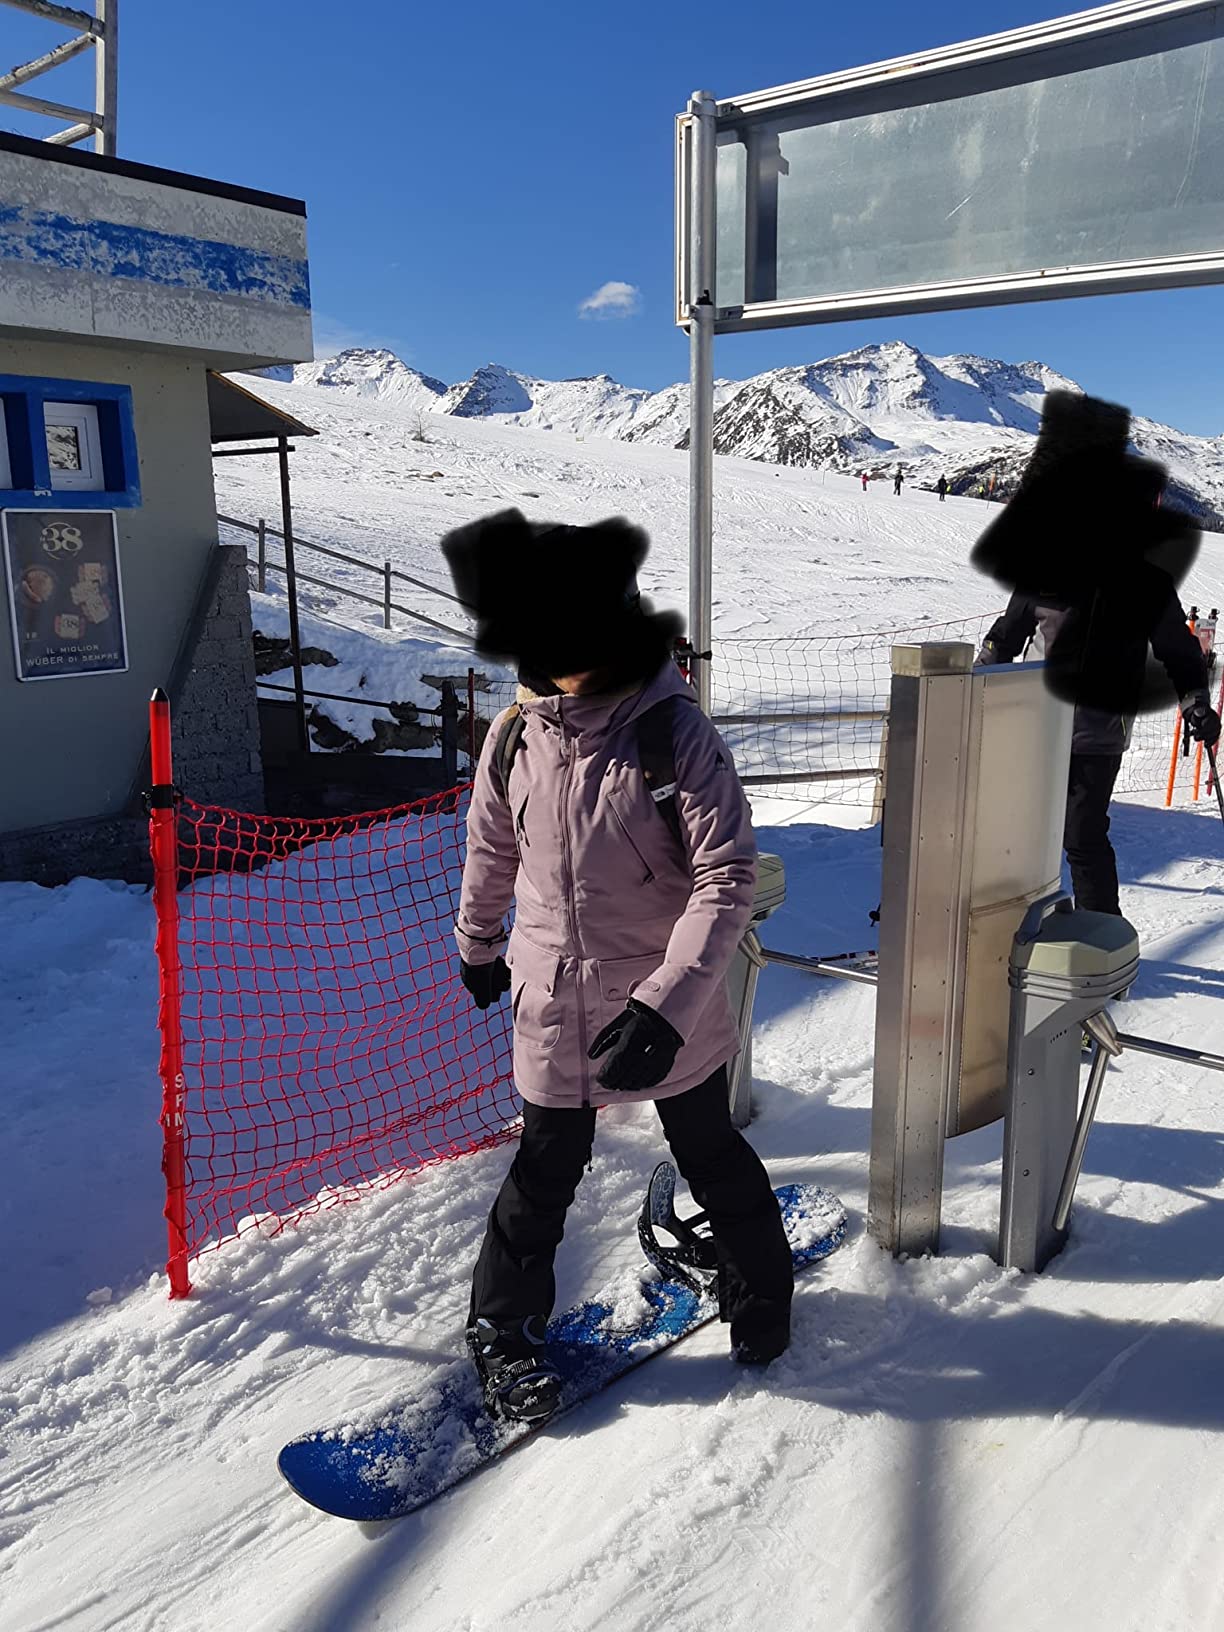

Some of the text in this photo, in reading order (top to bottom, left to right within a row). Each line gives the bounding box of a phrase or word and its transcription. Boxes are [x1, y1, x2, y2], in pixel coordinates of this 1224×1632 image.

[42, 527, 84, 551] 38
[46, 644, 99, 655] IL MIGLIOR
[82, 652, 119, 662] SEMPRE
